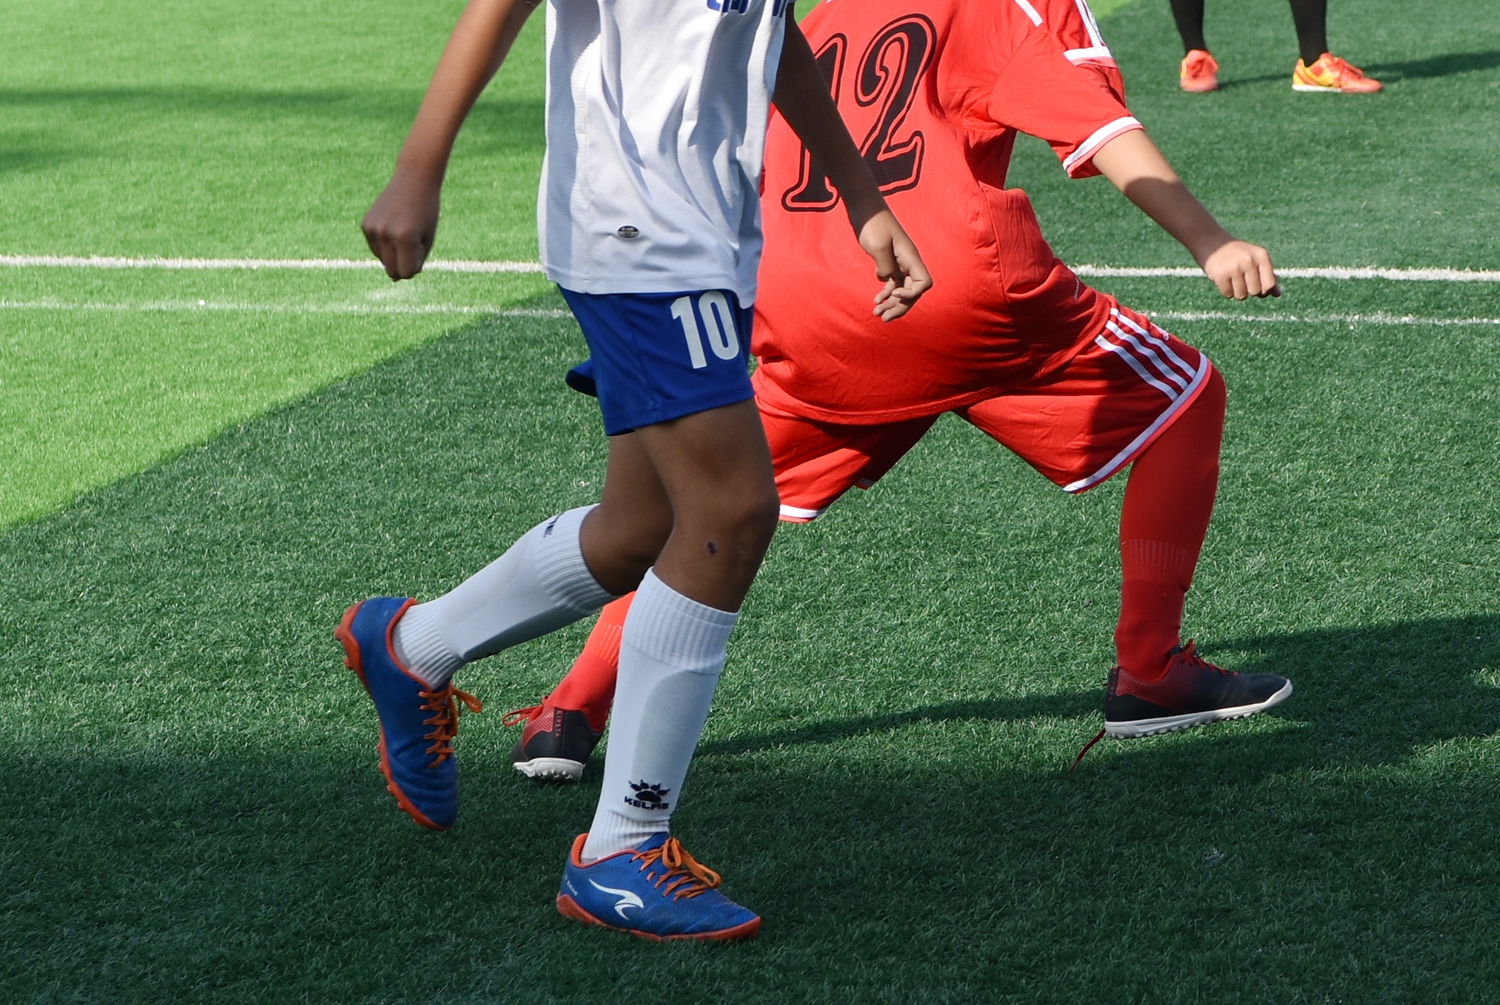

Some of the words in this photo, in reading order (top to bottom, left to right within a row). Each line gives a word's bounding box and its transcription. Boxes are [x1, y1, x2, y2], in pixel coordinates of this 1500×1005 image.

[781, 13, 937, 212] 12
[670, 290, 740, 369] 10
[623, 795, 670, 810] KELME
